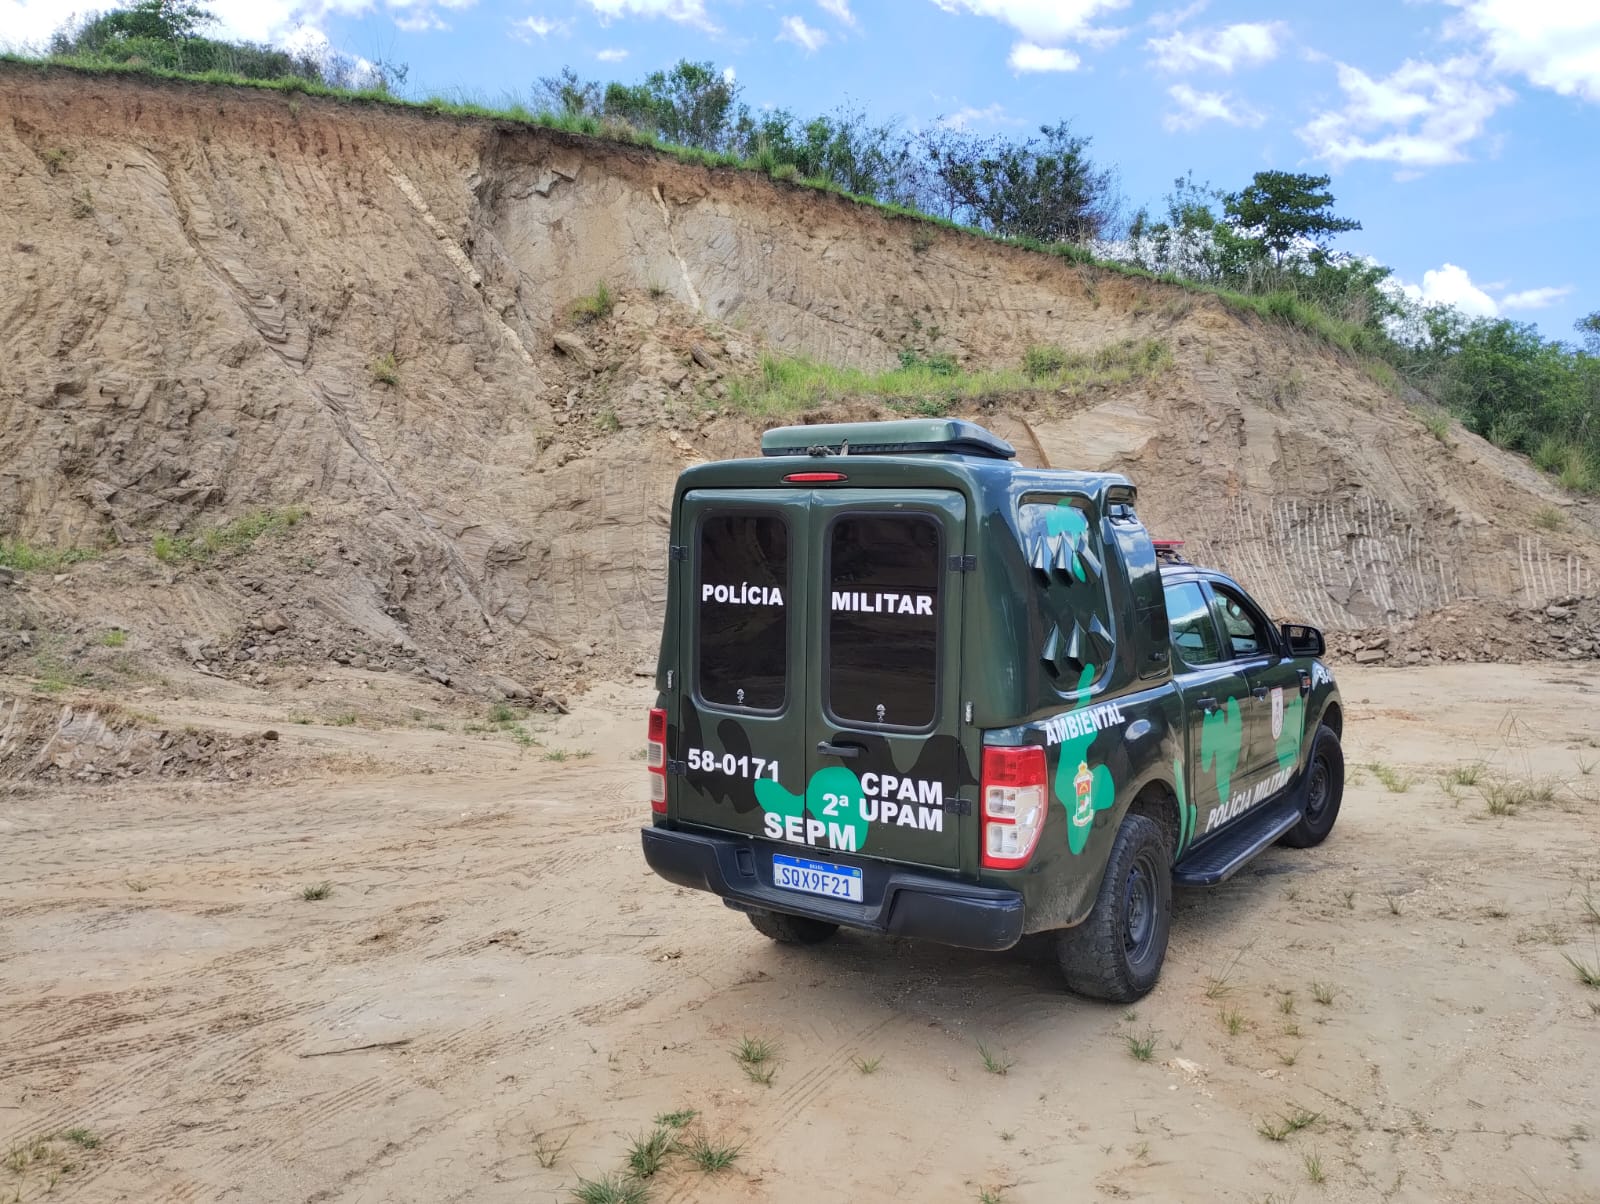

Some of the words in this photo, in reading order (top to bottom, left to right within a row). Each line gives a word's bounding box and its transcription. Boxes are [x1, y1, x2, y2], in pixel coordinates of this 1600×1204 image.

[702, 582, 784, 606] POLÍCIA
[831, 591, 933, 616] MILITAR
[1045, 702, 1126, 746] AMBIENTAL
[688, 748, 779, 783] 58-0171
[861, 772, 943, 805] CPAM
[1205, 790, 1252, 834] POLÍCIA
[1251, 766, 1292, 807] MILITAR
[764, 812, 857, 852] SEPM
[858, 798, 943, 832] UPAM
[782, 867, 850, 897] SQX9F21
